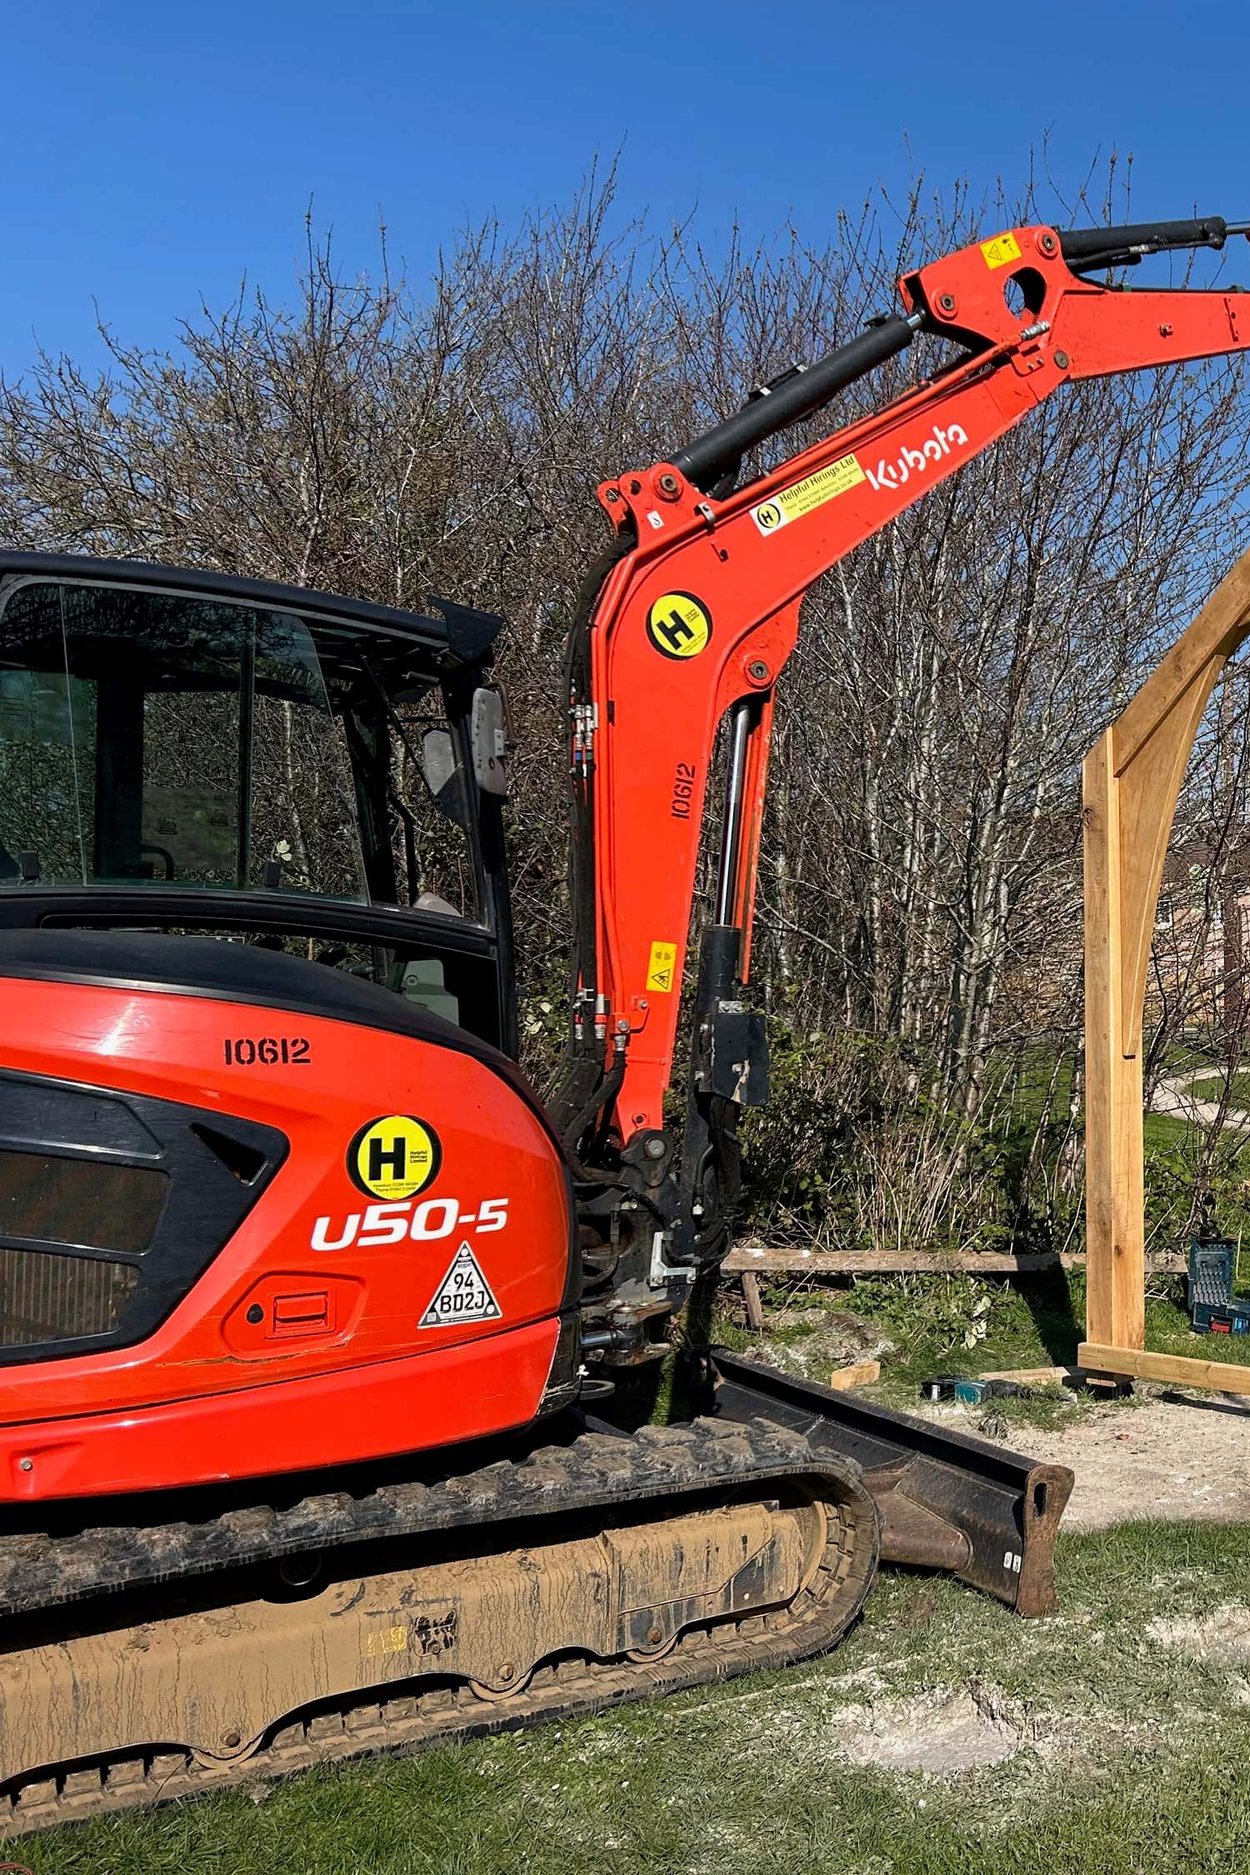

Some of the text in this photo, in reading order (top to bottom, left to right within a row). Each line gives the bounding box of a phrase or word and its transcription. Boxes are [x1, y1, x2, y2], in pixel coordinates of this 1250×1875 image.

[865, 423, 969, 491] Kubota
[779, 482, 811, 503] Helpful
[809, 465, 841, 487] Hirings
[839, 455, 855, 469] Ltd
[760, 510, 774, 524] H
[656, 609, 695, 650] H
[671, 762, 696, 820] 10612
[225, 1038, 311, 1065] 10612
[368, 1137, 406, 1181] H
[454, 1271, 475, 1292] 94
[440, 1291, 485, 1314] BD2J
